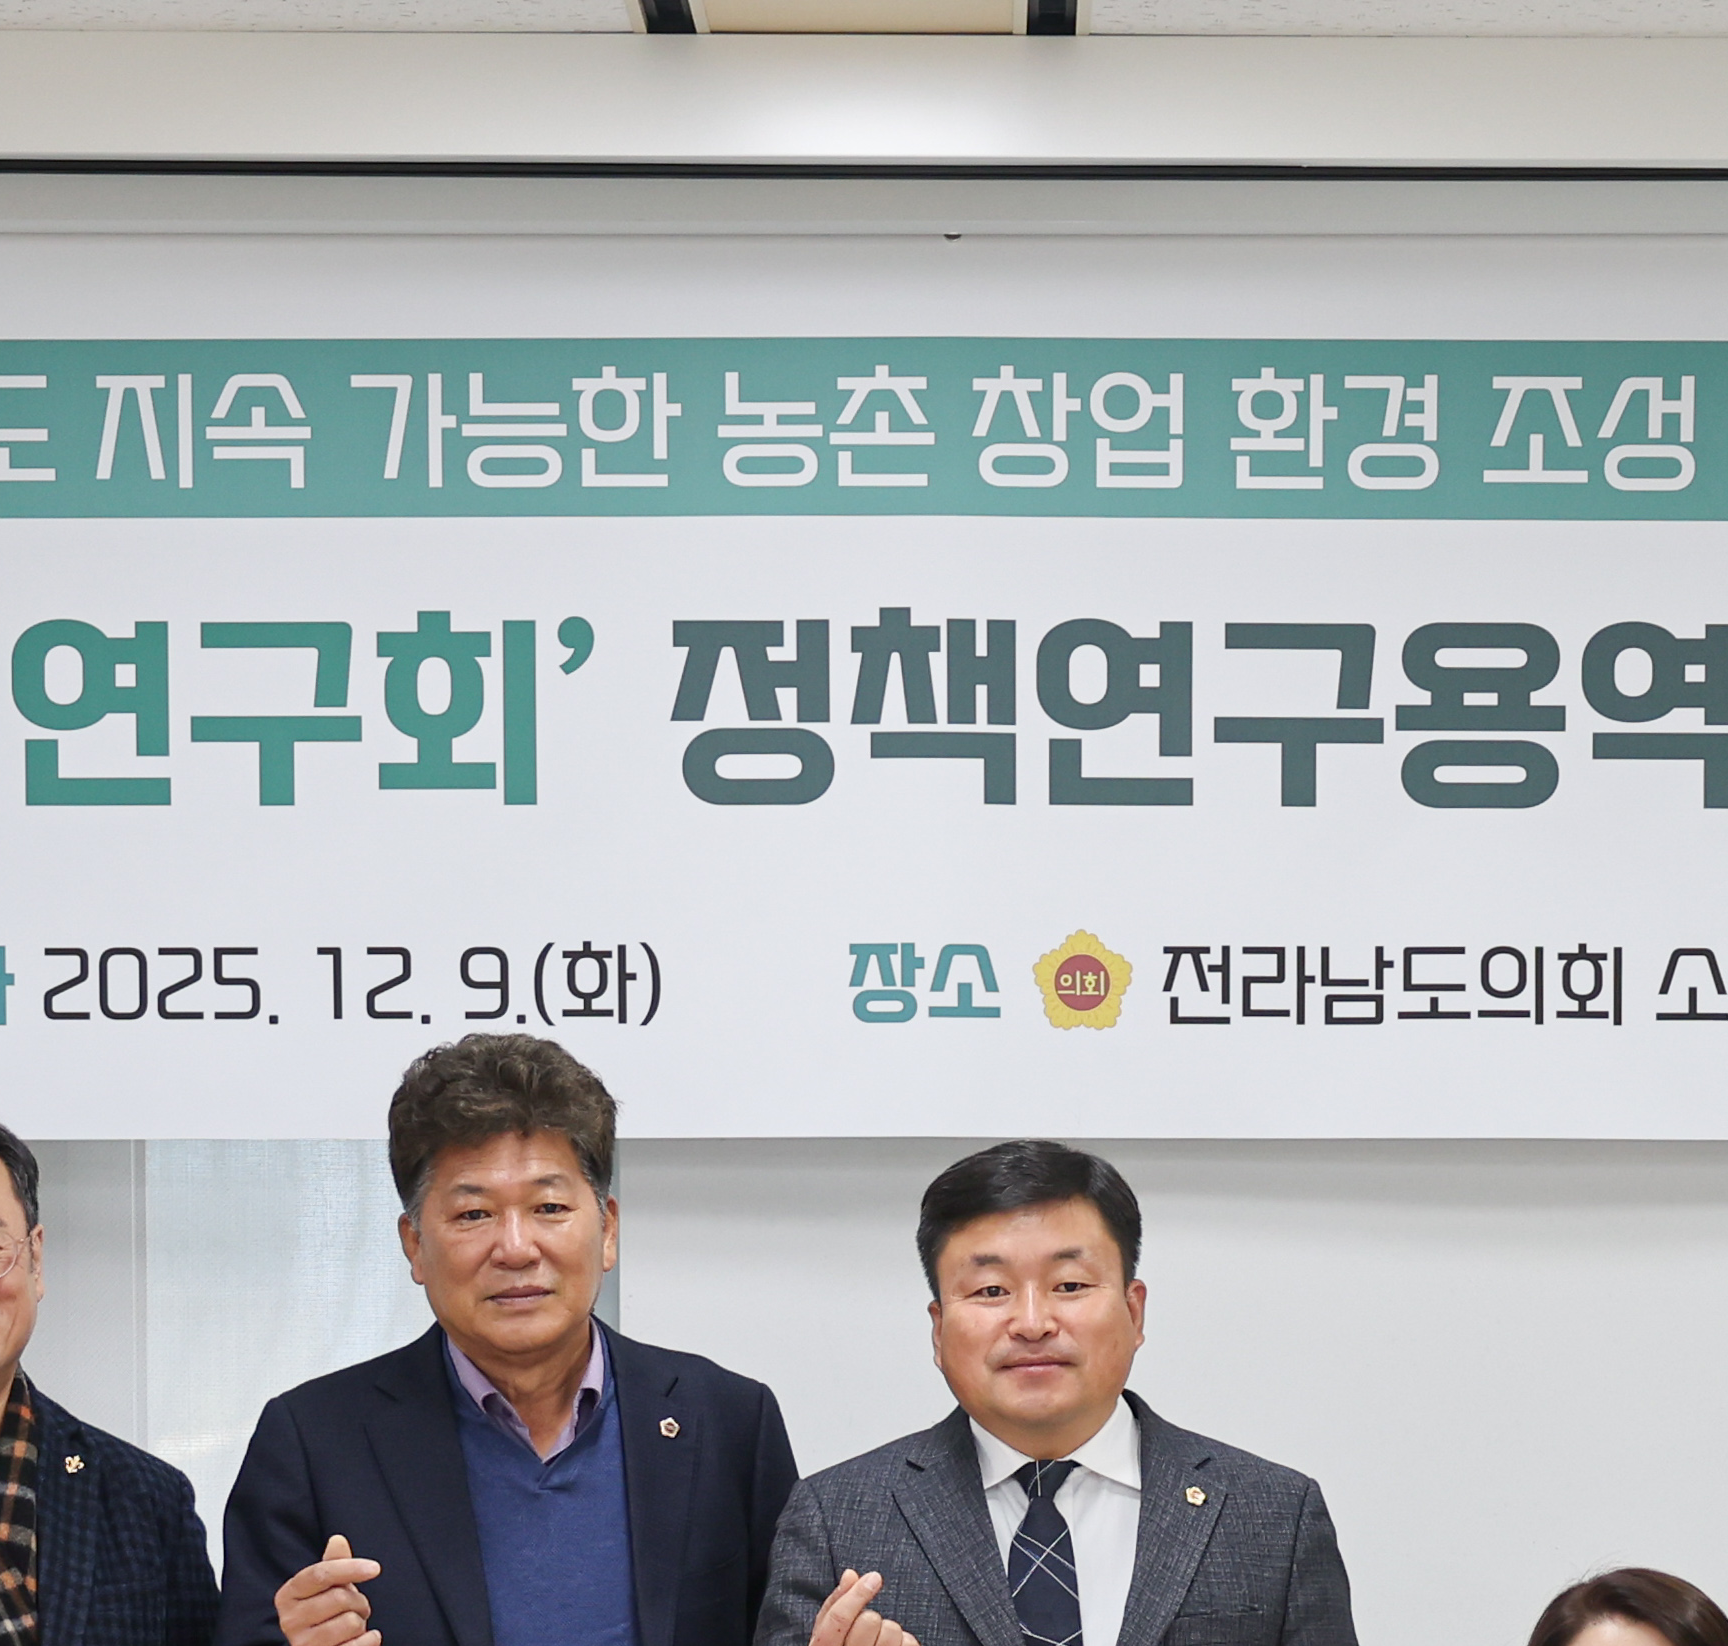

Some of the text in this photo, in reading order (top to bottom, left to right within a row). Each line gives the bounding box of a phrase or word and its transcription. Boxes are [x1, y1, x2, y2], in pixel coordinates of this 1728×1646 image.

[96, 374, 311, 488] 지속
[351, 366, 681, 488] 가능한
[718, 365, 935, 487] 농촌
[972, 365, 1183, 488] 창업
[1230, 368, 1439, 490] 환경
[1483, 376, 1695, 491] 조성
[44, 947, 279, 1025] 2025.
[317, 947, 431, 1025] 12.
[459, 940, 661, 1027] 9.(화)
[849, 942, 1001, 1024] 장소
[1162, 942, 1622, 1027] 전라남도의회
[1058, 971, 1105, 996] 의회
